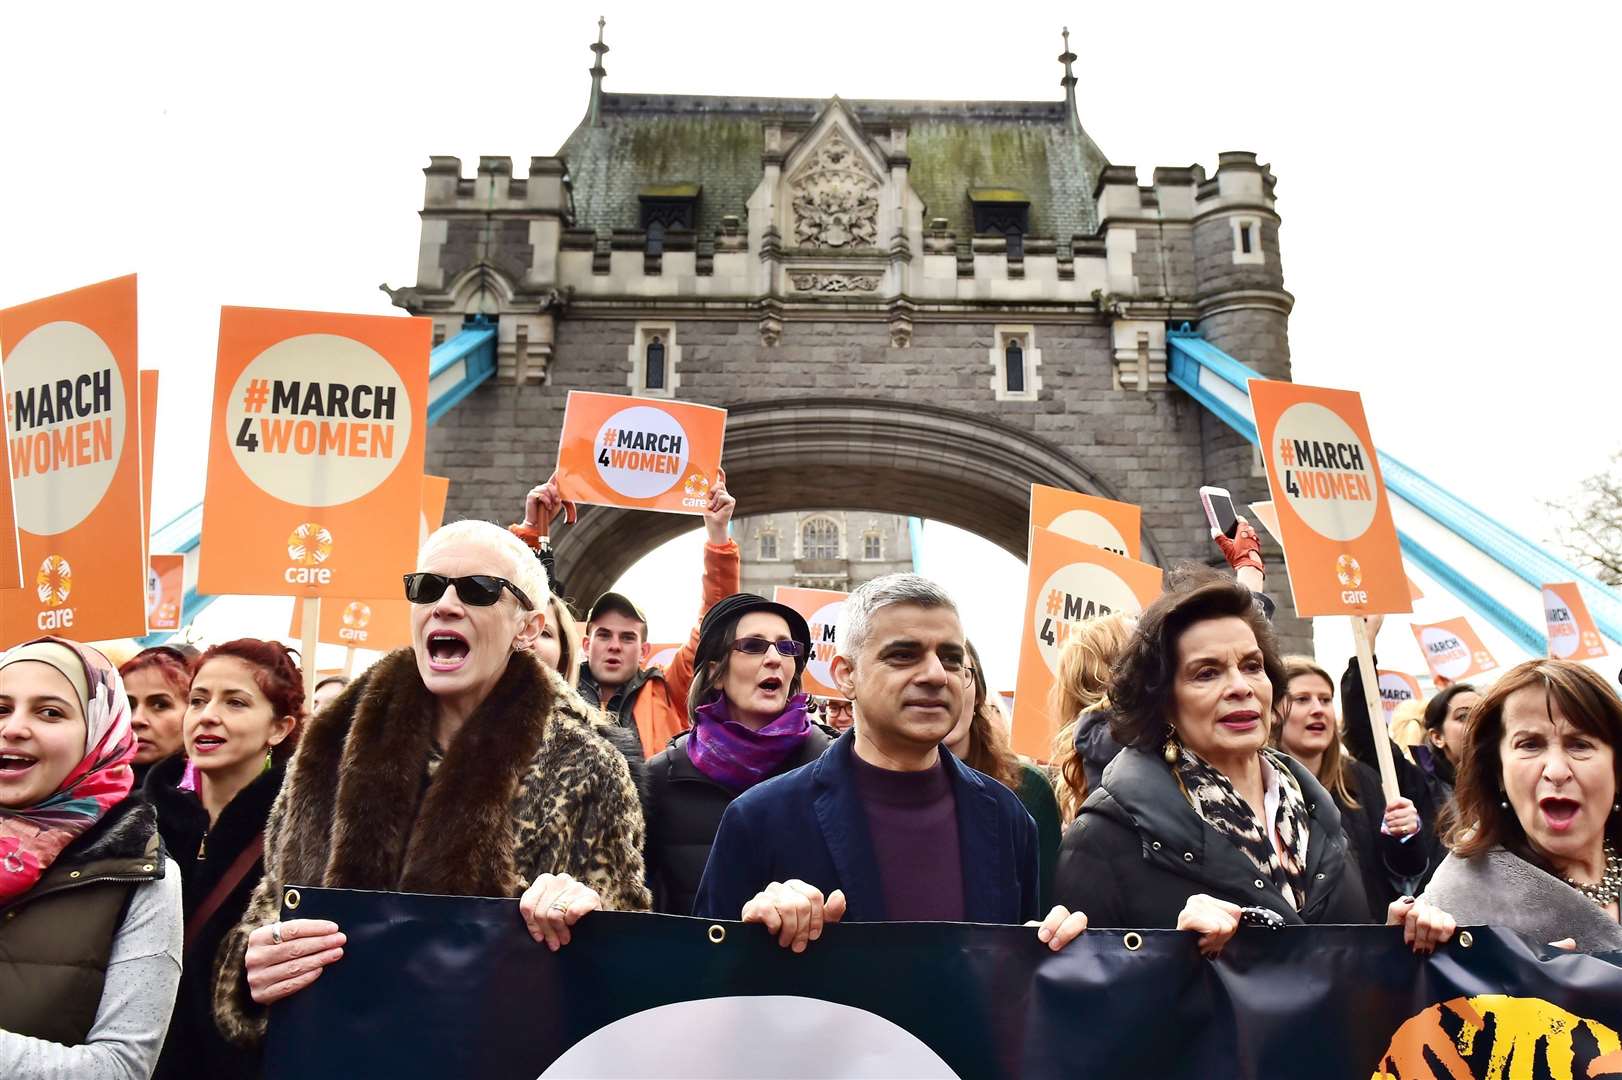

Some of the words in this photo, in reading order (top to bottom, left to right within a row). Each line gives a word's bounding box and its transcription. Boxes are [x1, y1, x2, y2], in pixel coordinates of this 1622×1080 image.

[243, 379, 396, 420] #MARCH
[236, 417, 394, 459] 4WOMEN
[603, 427, 682, 454] #MARCH
[598, 448, 680, 475] 4WOMEN
[1280, 438, 1364, 471] #MARCH
[1286, 470, 1372, 501] 4WOMEN
[682, 497, 706, 508] care
[284, 567, 332, 584] care
[1342, 590, 1368, 604] care
[37, 608, 74, 630] care
[338, 628, 368, 641] care
